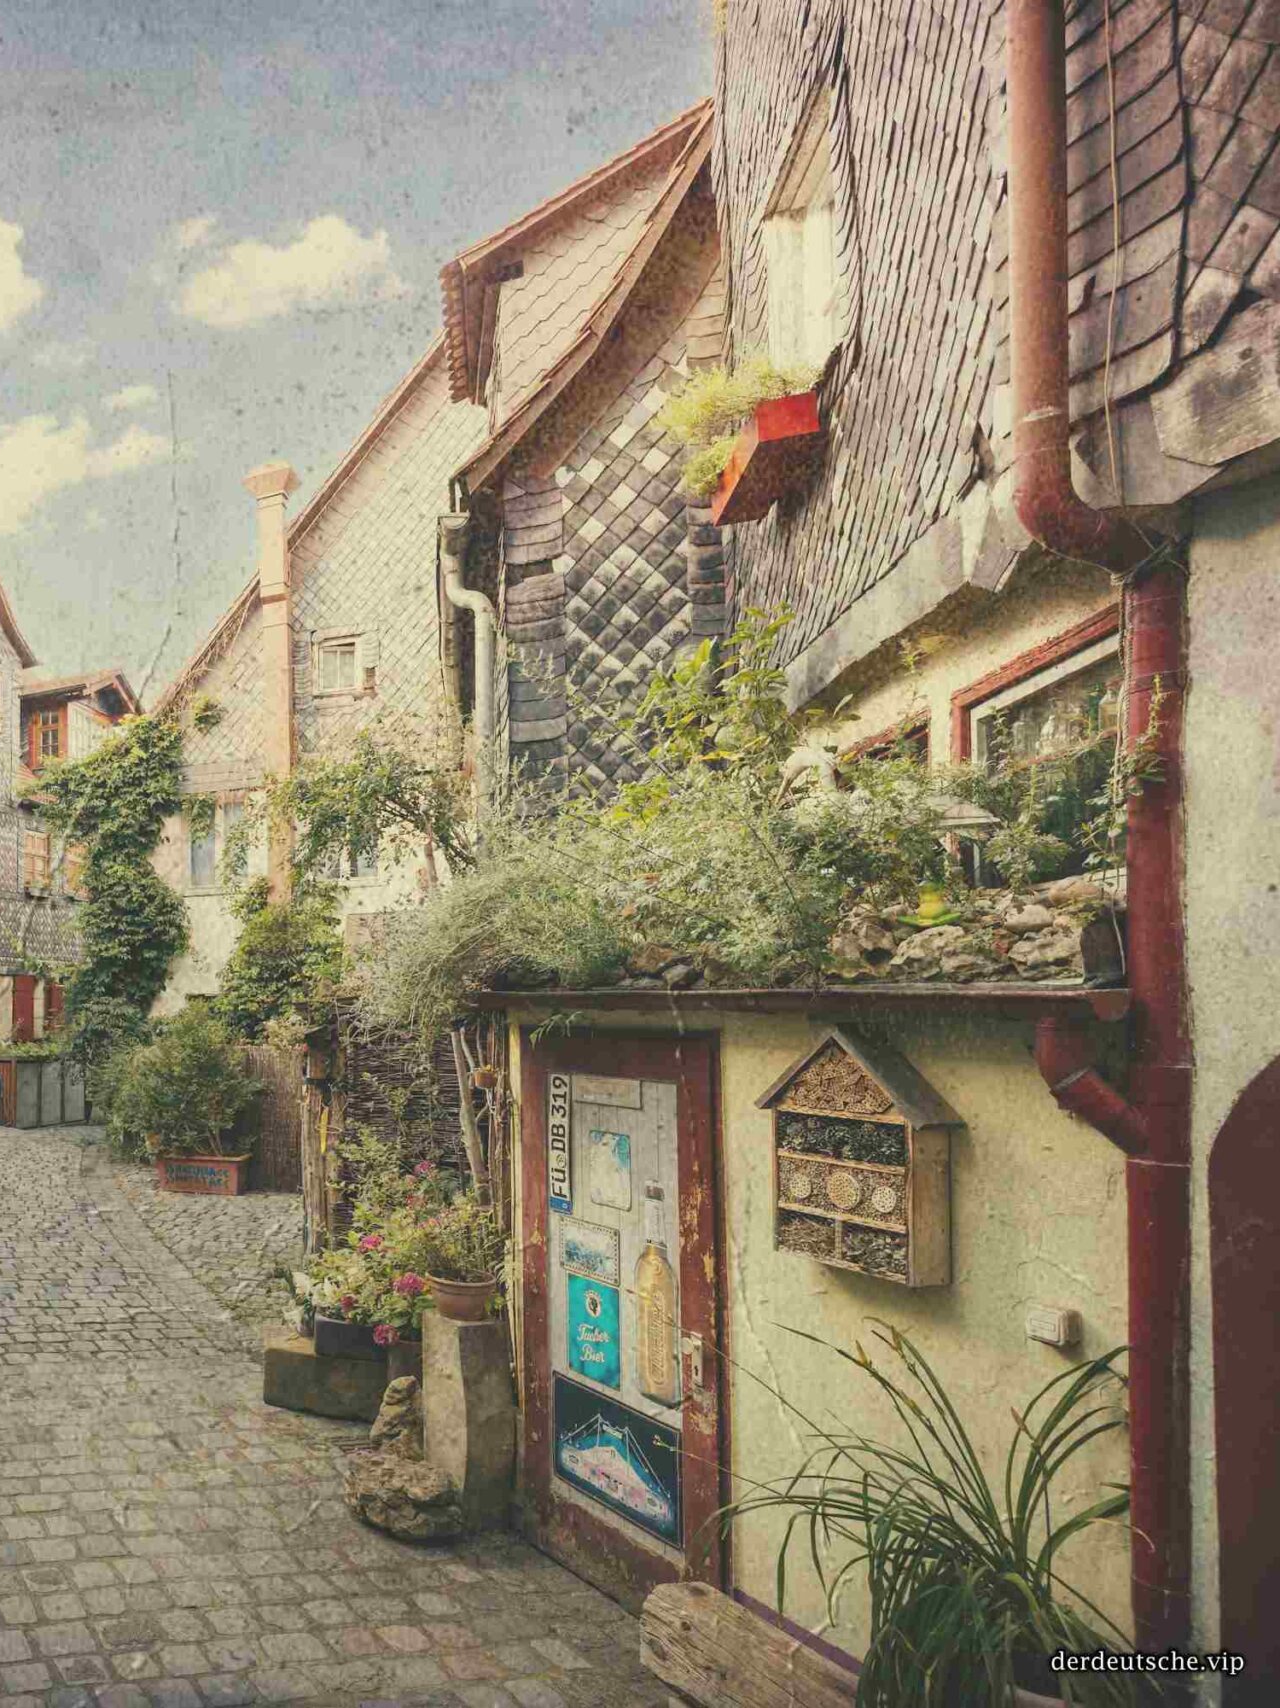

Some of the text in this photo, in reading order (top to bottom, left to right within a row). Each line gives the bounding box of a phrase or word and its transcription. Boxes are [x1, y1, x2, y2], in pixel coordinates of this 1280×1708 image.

[551, 1076, 568, 1199] FÜ DB 319
[580, 1343, 605, 1363] Bier
